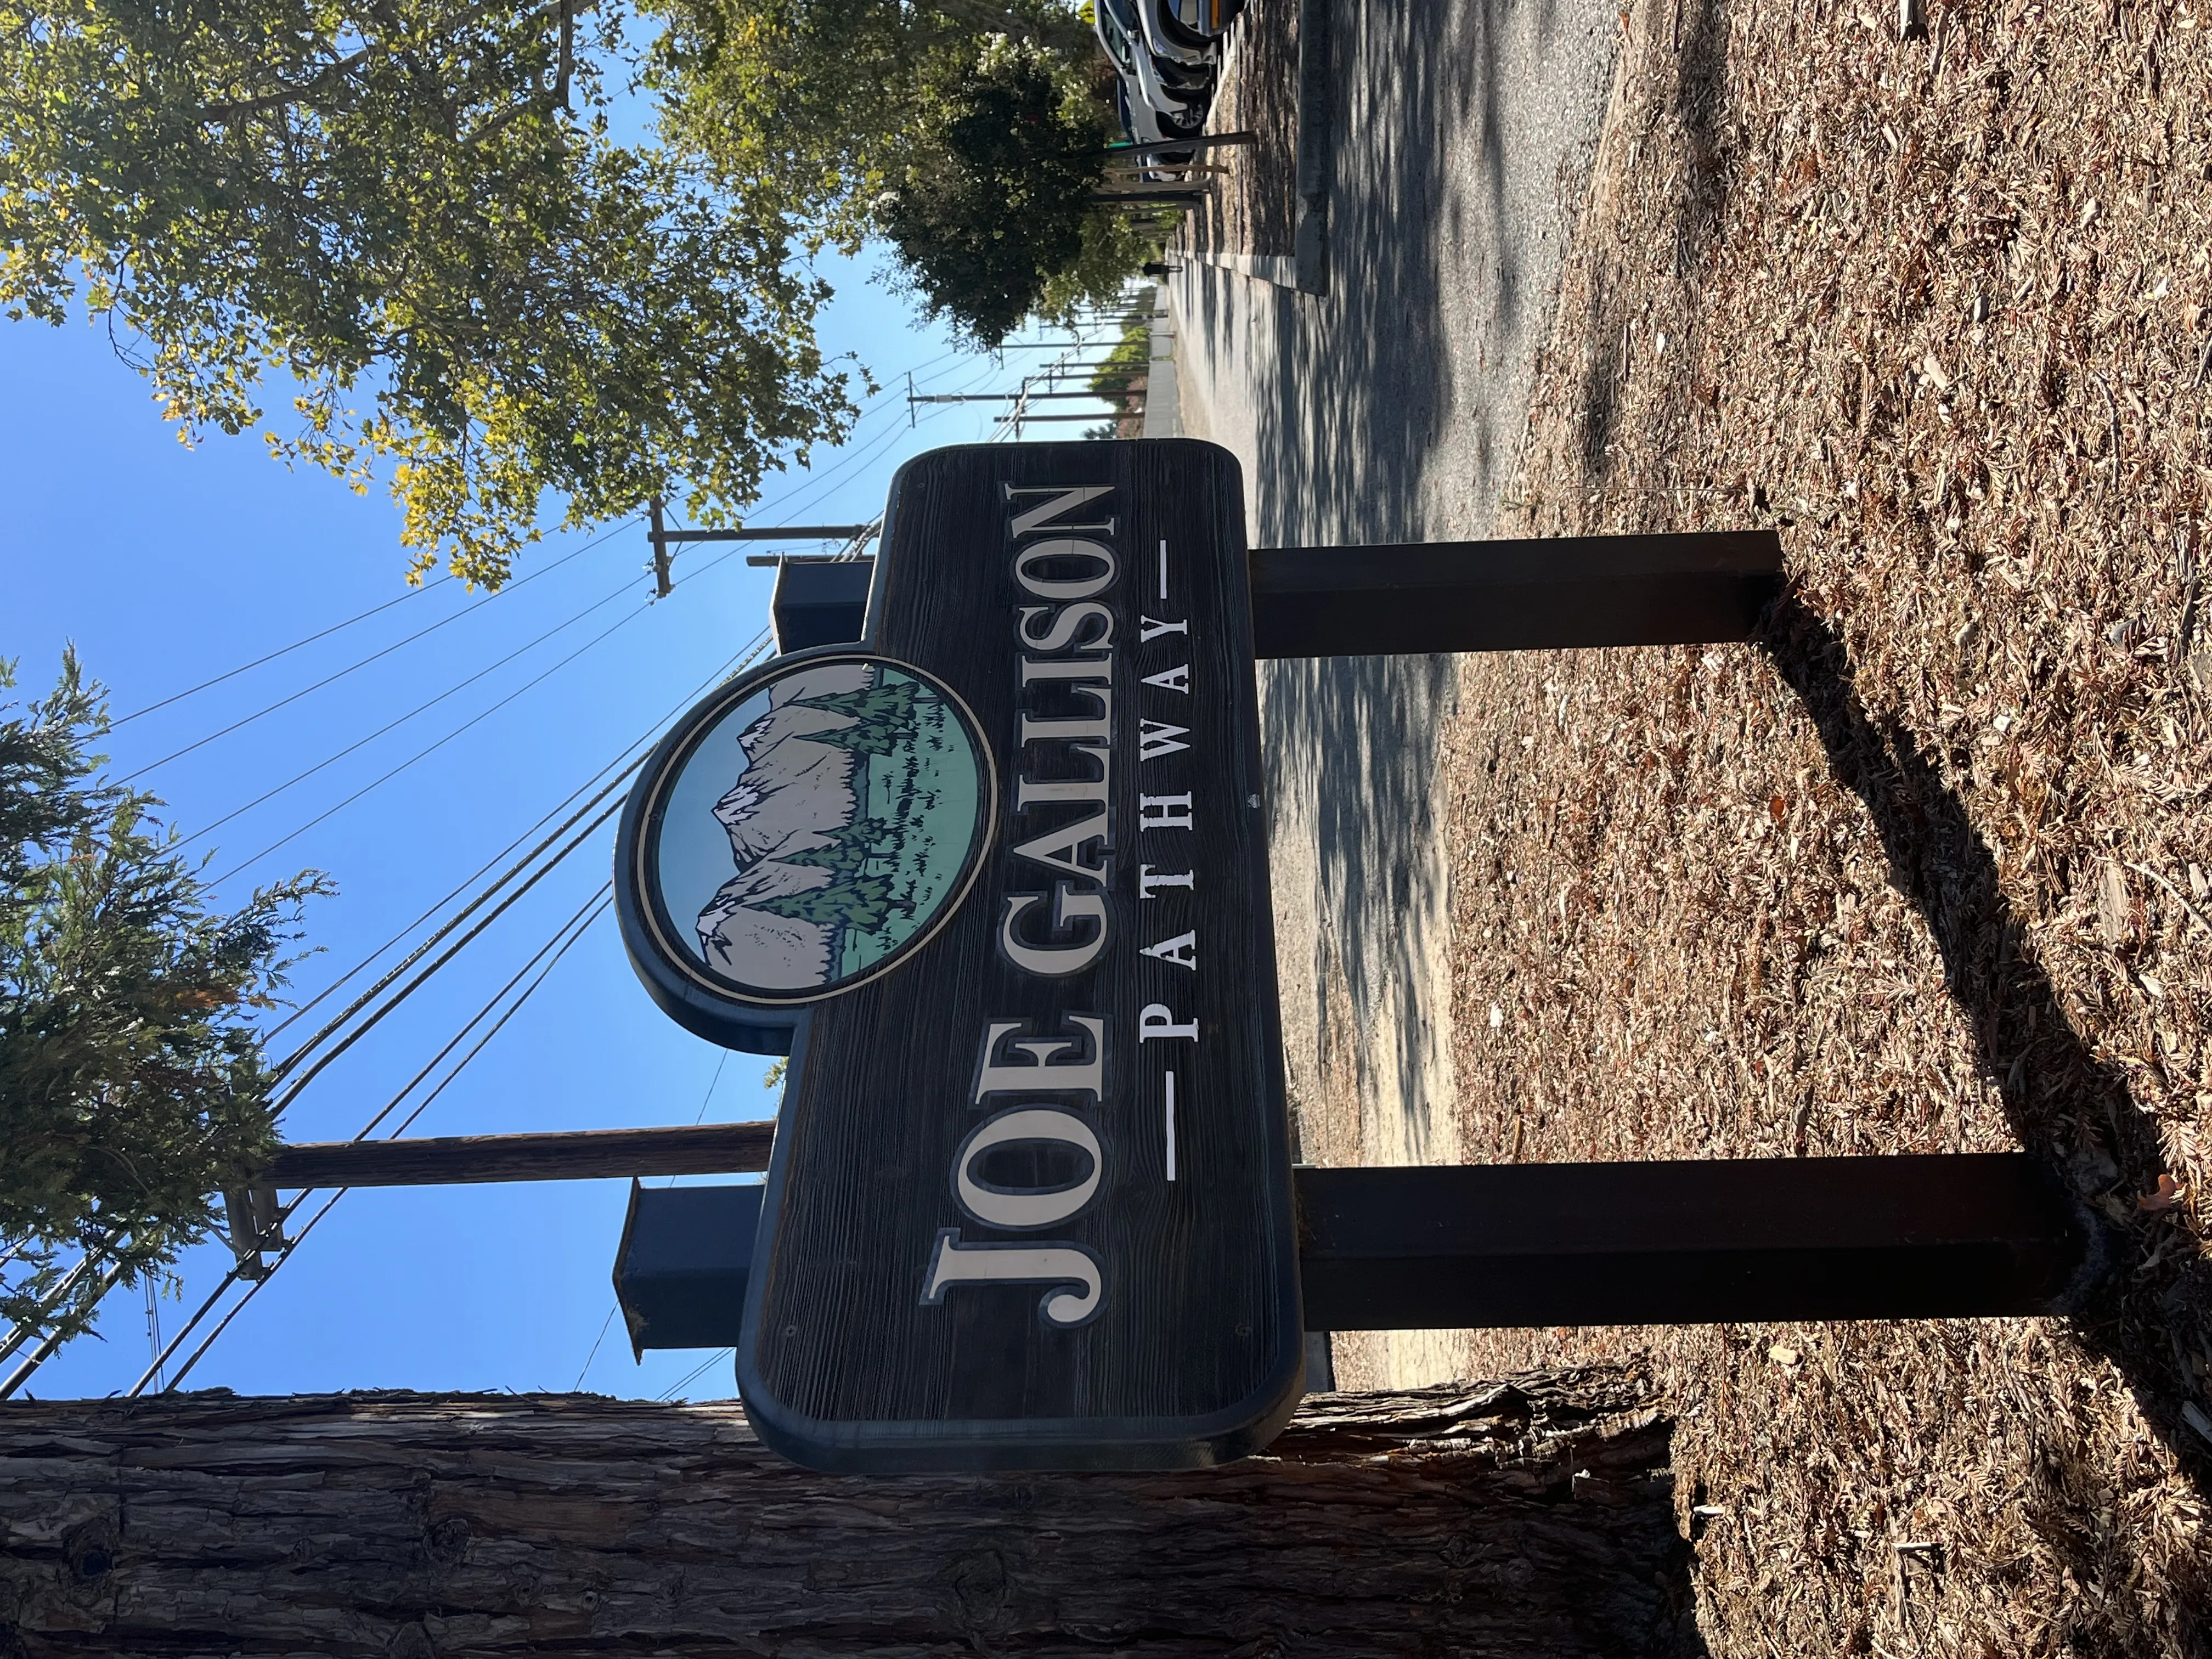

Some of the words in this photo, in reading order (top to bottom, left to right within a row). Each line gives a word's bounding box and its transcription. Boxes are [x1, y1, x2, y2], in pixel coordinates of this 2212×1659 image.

[1002, 480, 1115, 974] GALLISON
[1139, 614, 1199, 1043] PATHWAY
[928, 1015, 1103, 1323] JOE
